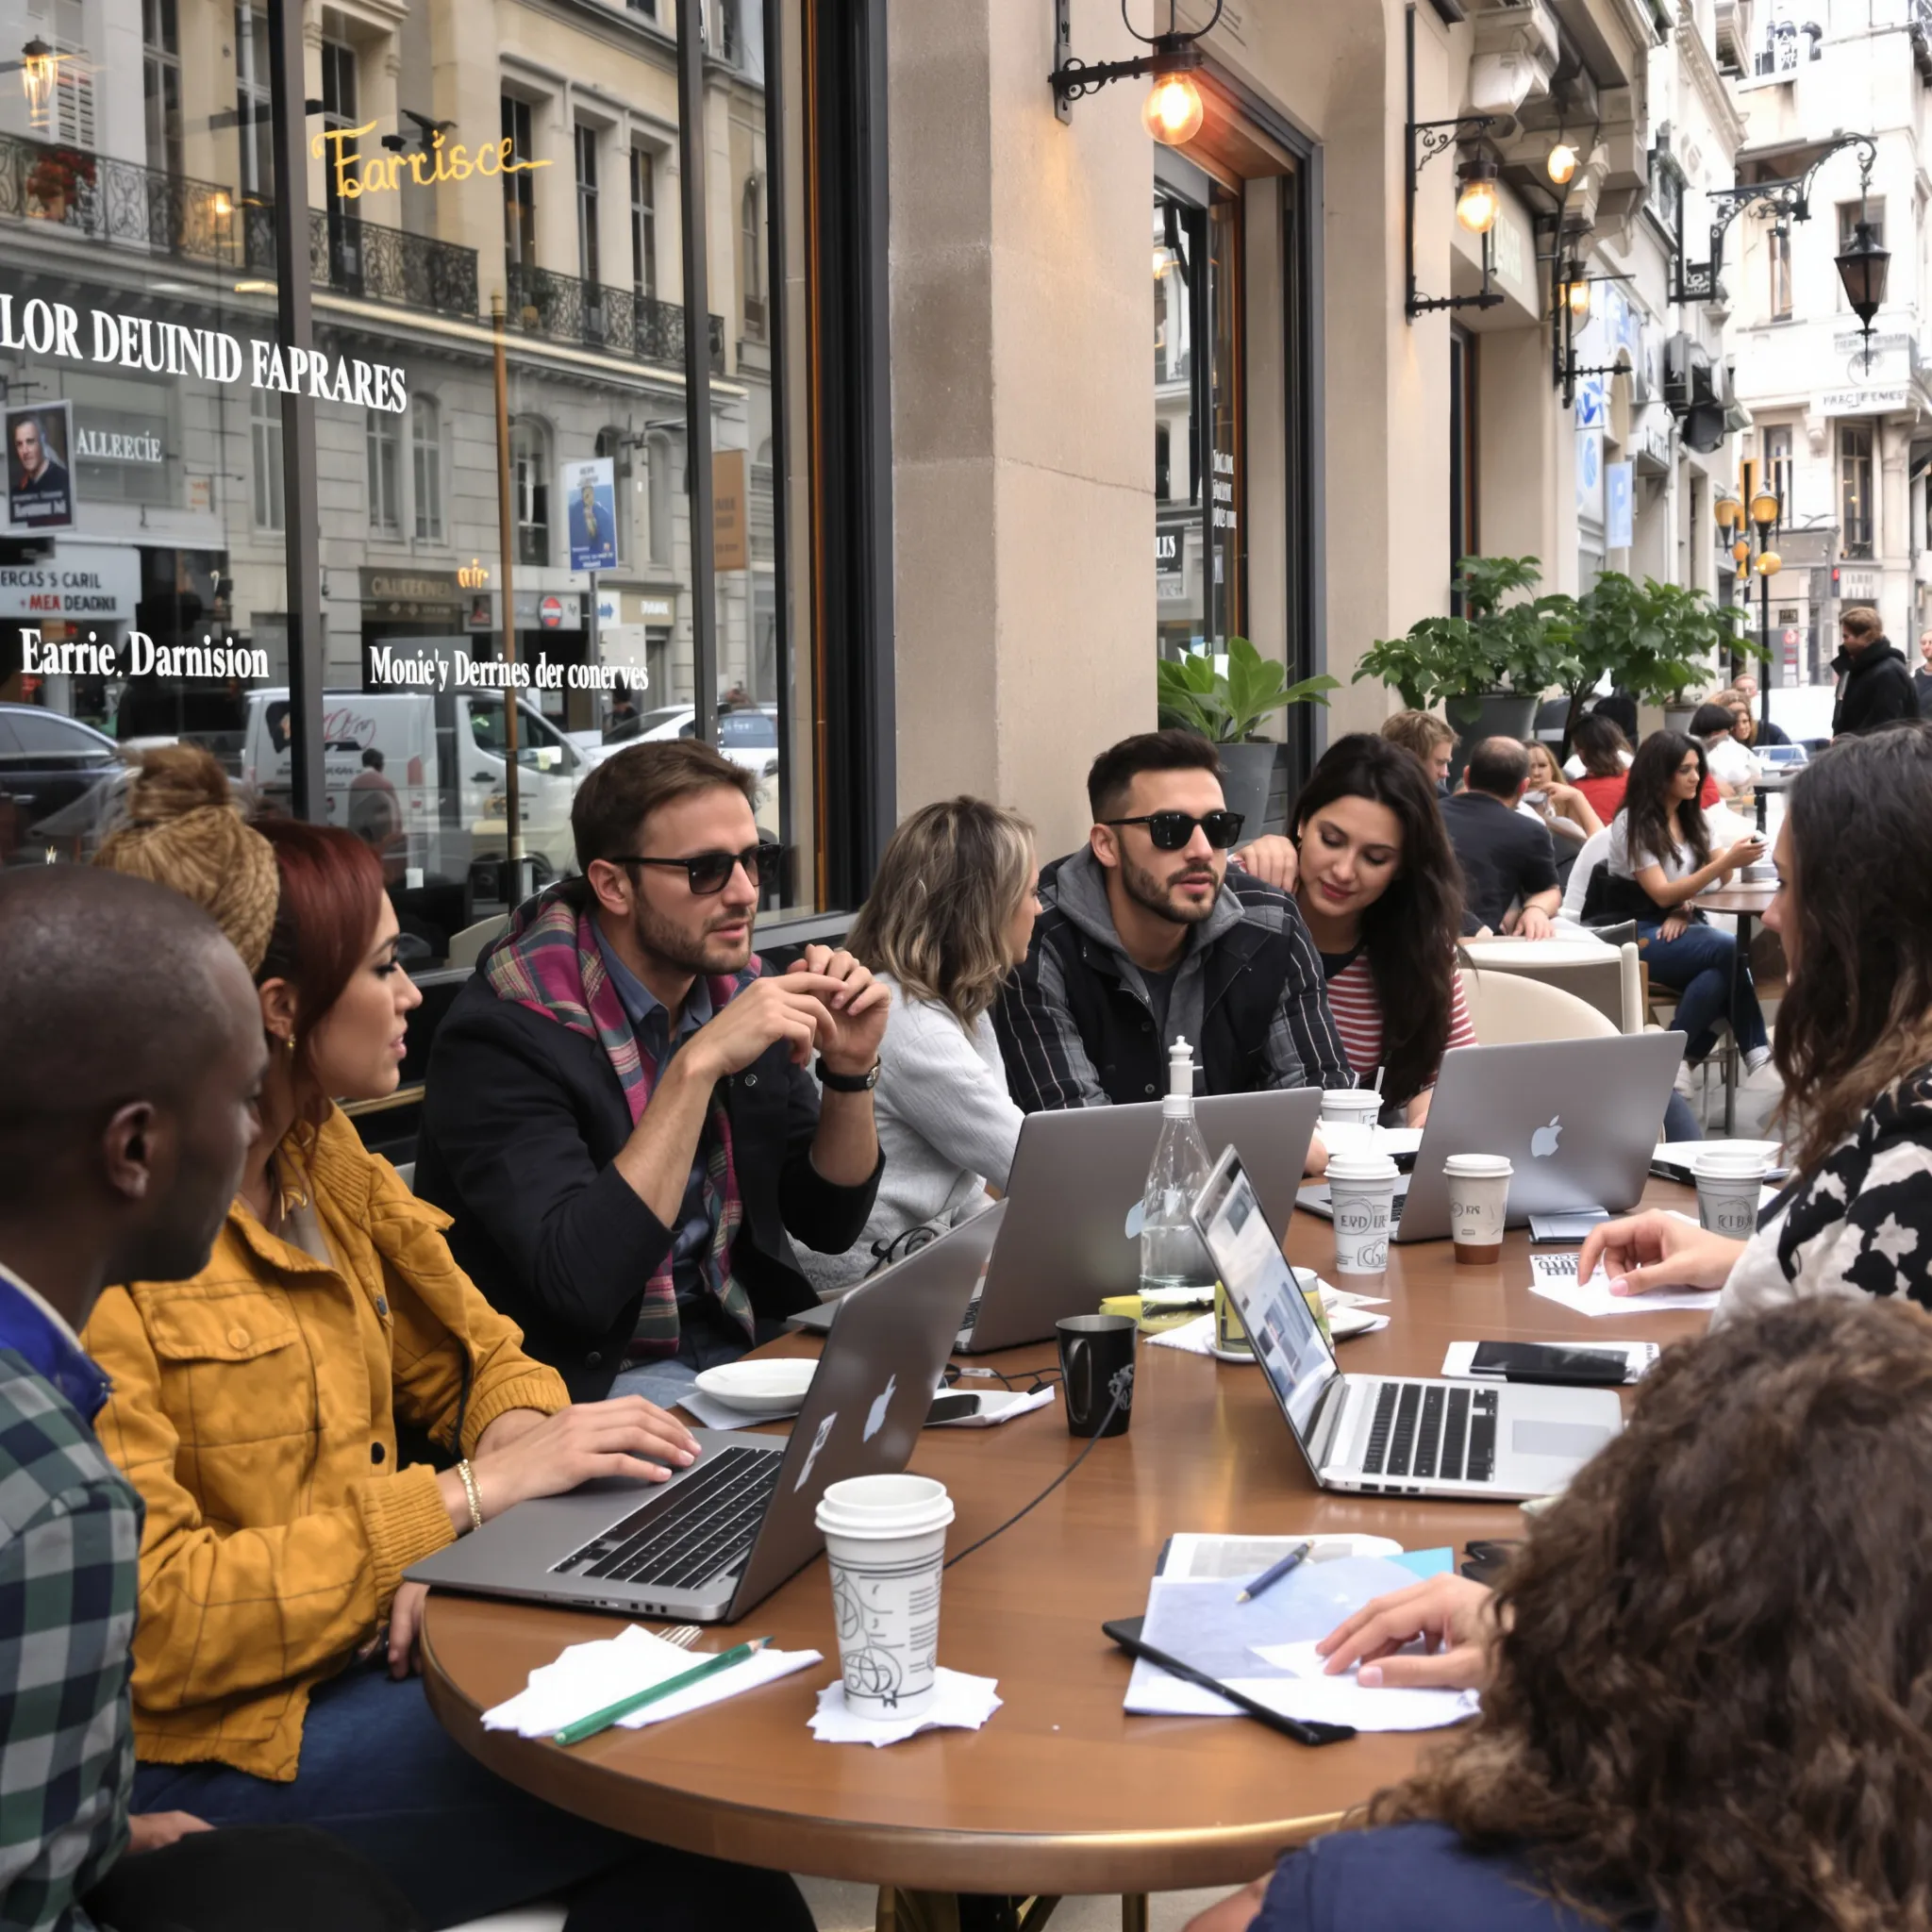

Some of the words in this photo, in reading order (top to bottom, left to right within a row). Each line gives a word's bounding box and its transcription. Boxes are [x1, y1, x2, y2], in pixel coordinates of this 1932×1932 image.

[0, 293, 83, 359] LOR
[250, 339, 408, 414] FAPRARES
[128, 630, 270, 678] Darnision
[535, 651, 564, 689] der
